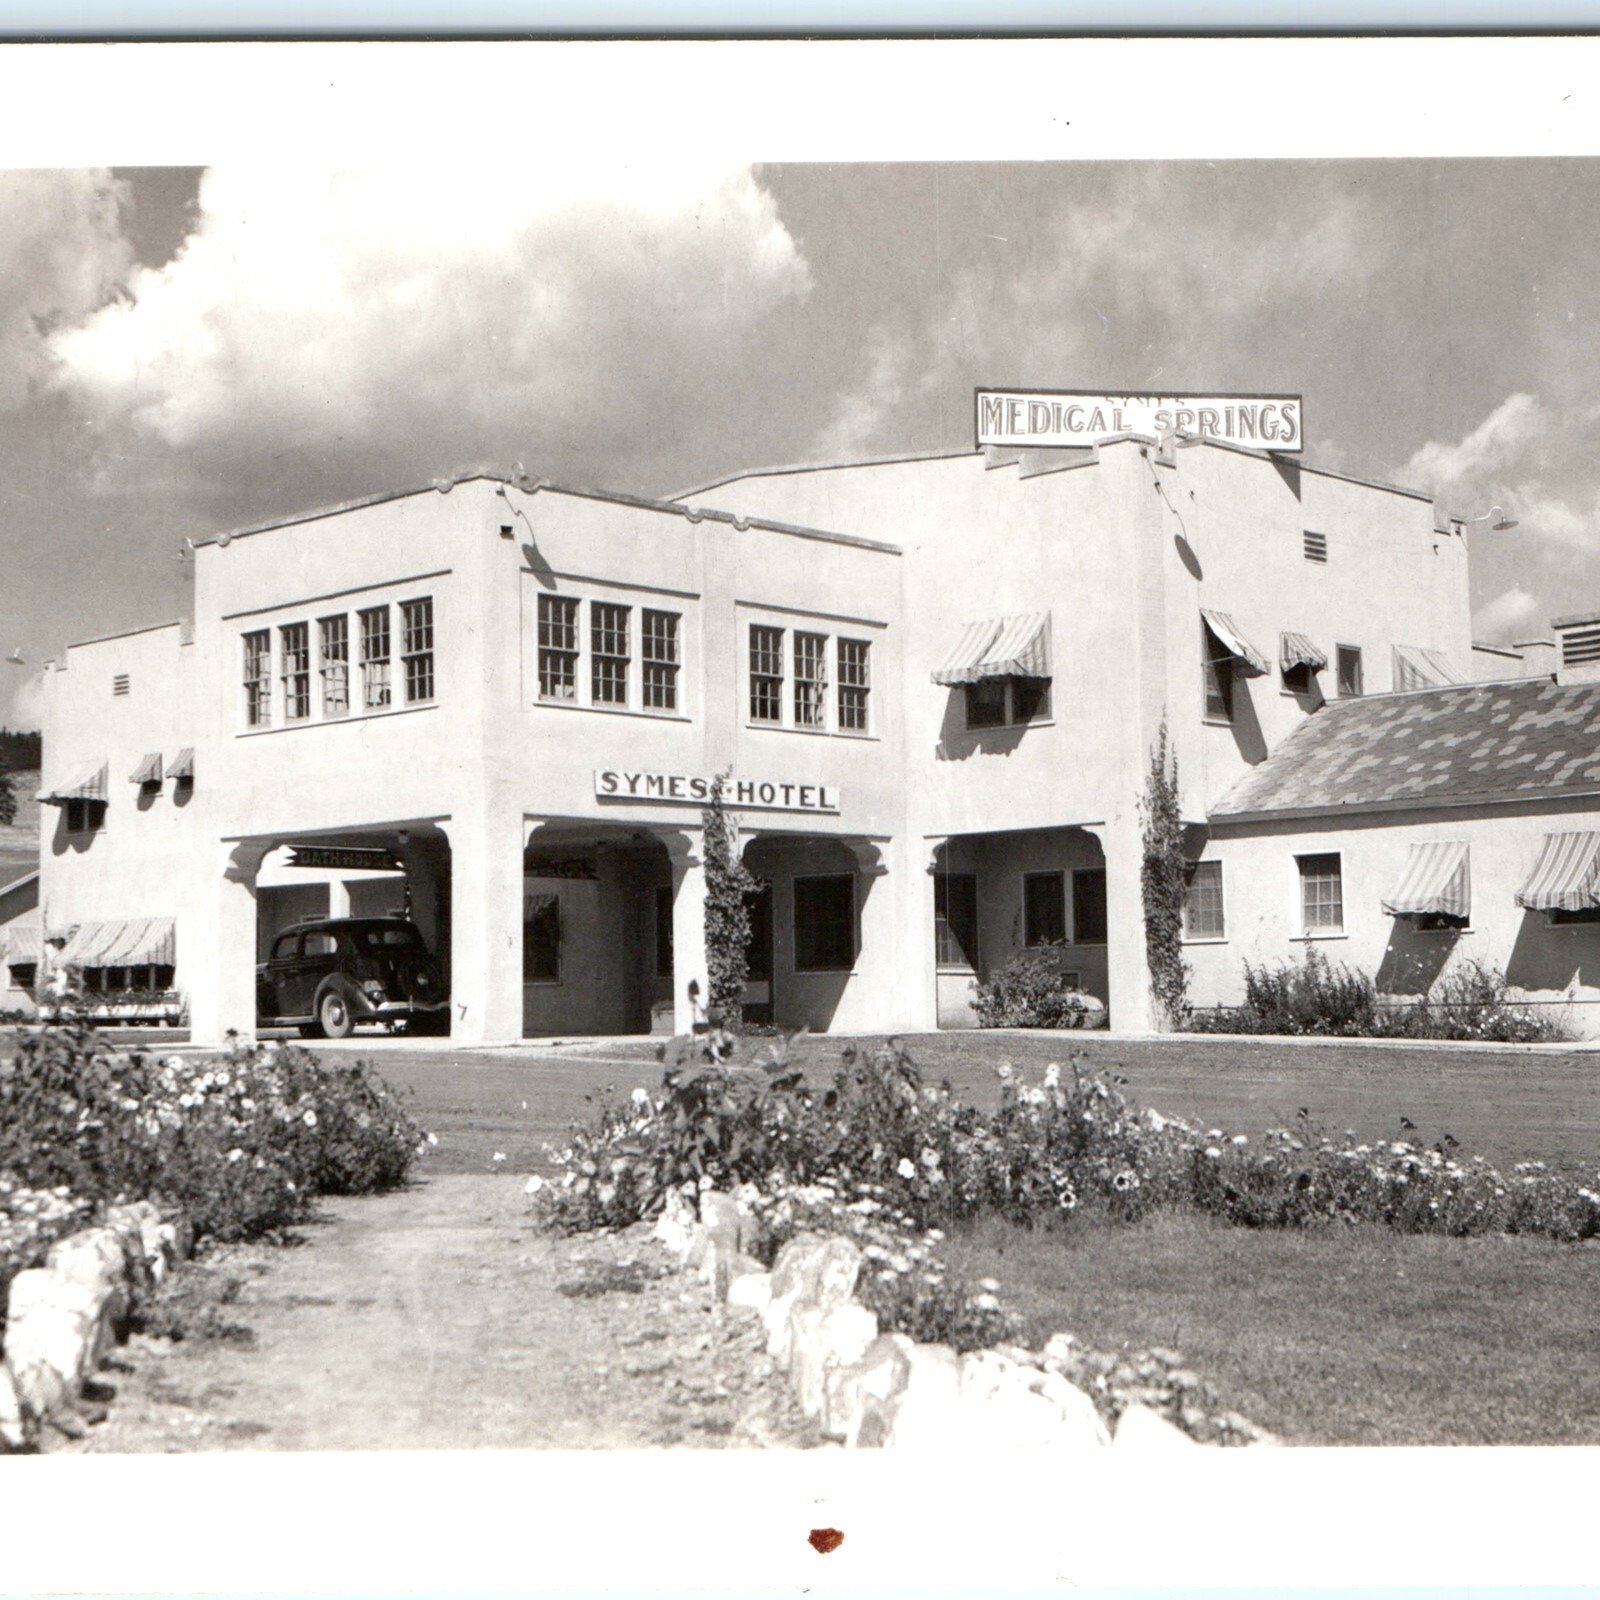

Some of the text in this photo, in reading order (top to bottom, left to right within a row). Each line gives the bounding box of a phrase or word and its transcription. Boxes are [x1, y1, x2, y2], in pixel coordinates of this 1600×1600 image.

[981, 396, 1299, 443] MEDICAL SPRINGS
[602, 771, 836, 809] SYMES HOTEL
